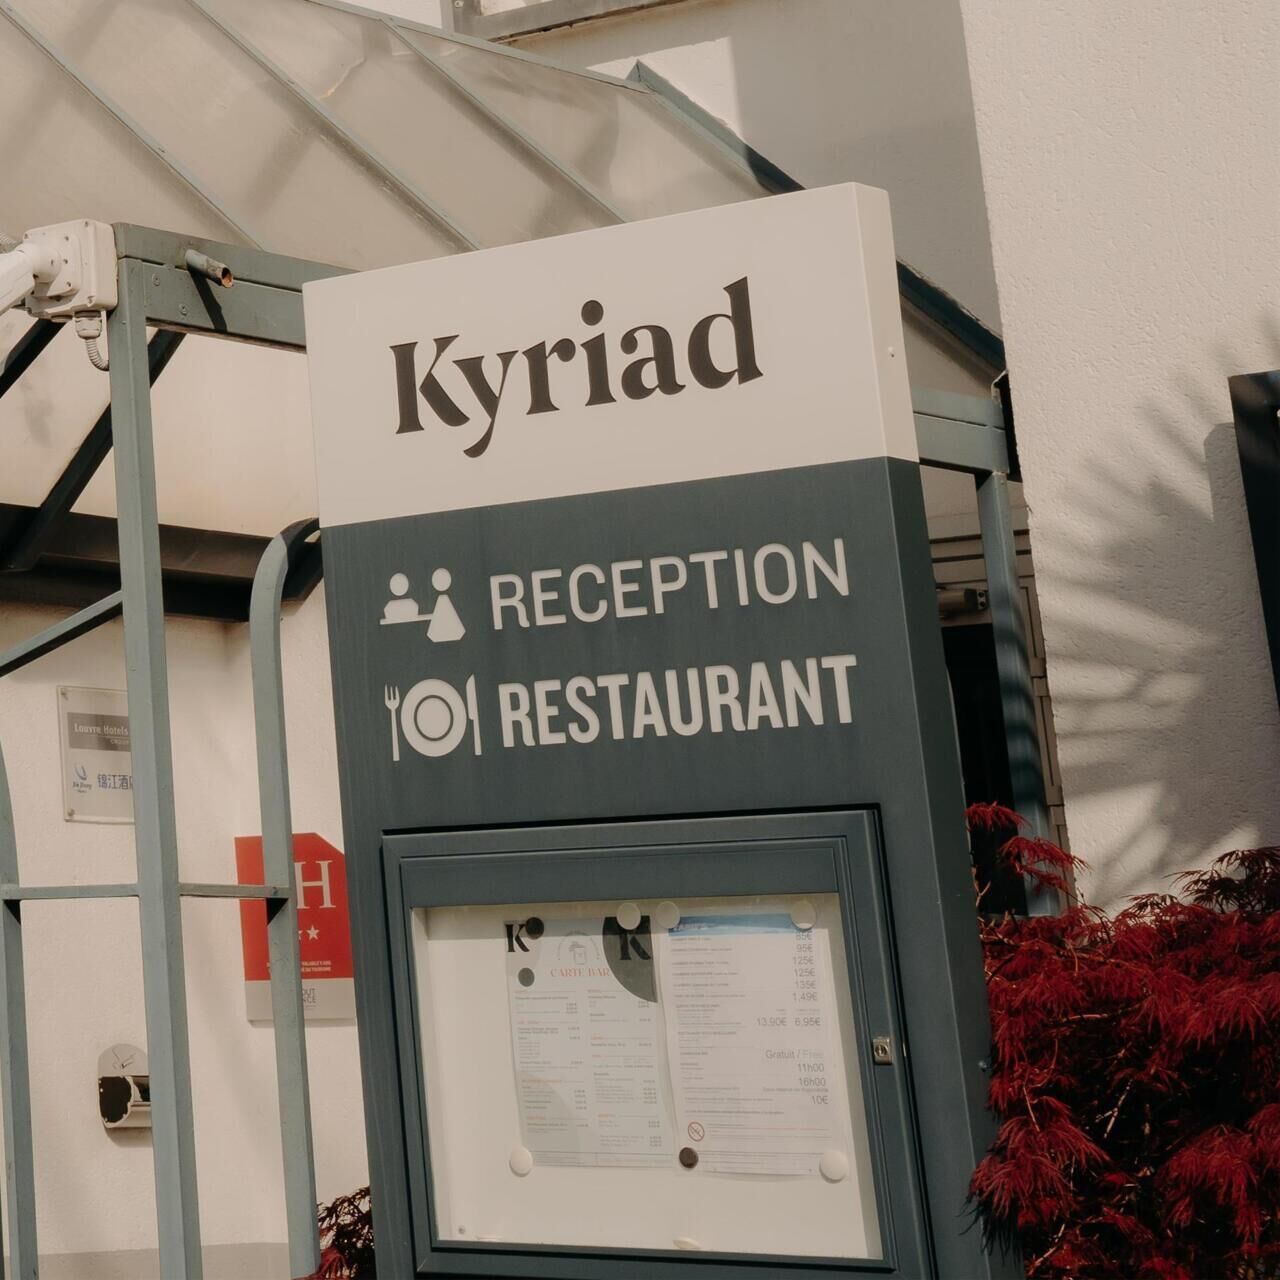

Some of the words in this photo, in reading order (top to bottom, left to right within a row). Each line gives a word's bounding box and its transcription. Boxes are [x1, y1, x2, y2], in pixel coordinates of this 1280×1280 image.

[389, 276, 764, 459] Kyriad
[489, 537, 851, 631] RECEPTION
[498, 654, 857, 749] RESTAURANT
[74, 723, 101, 734] Louvre
[104, 725, 129, 736] Hotels
[294, 860, 336, 909] H
[764, 1049, 795, 1059] Gratuit
[798, 1062, 825, 1073] 11h00
[798, 1076, 827, 1087] 16h00
[810, 1094, 829, 1105] 10€
